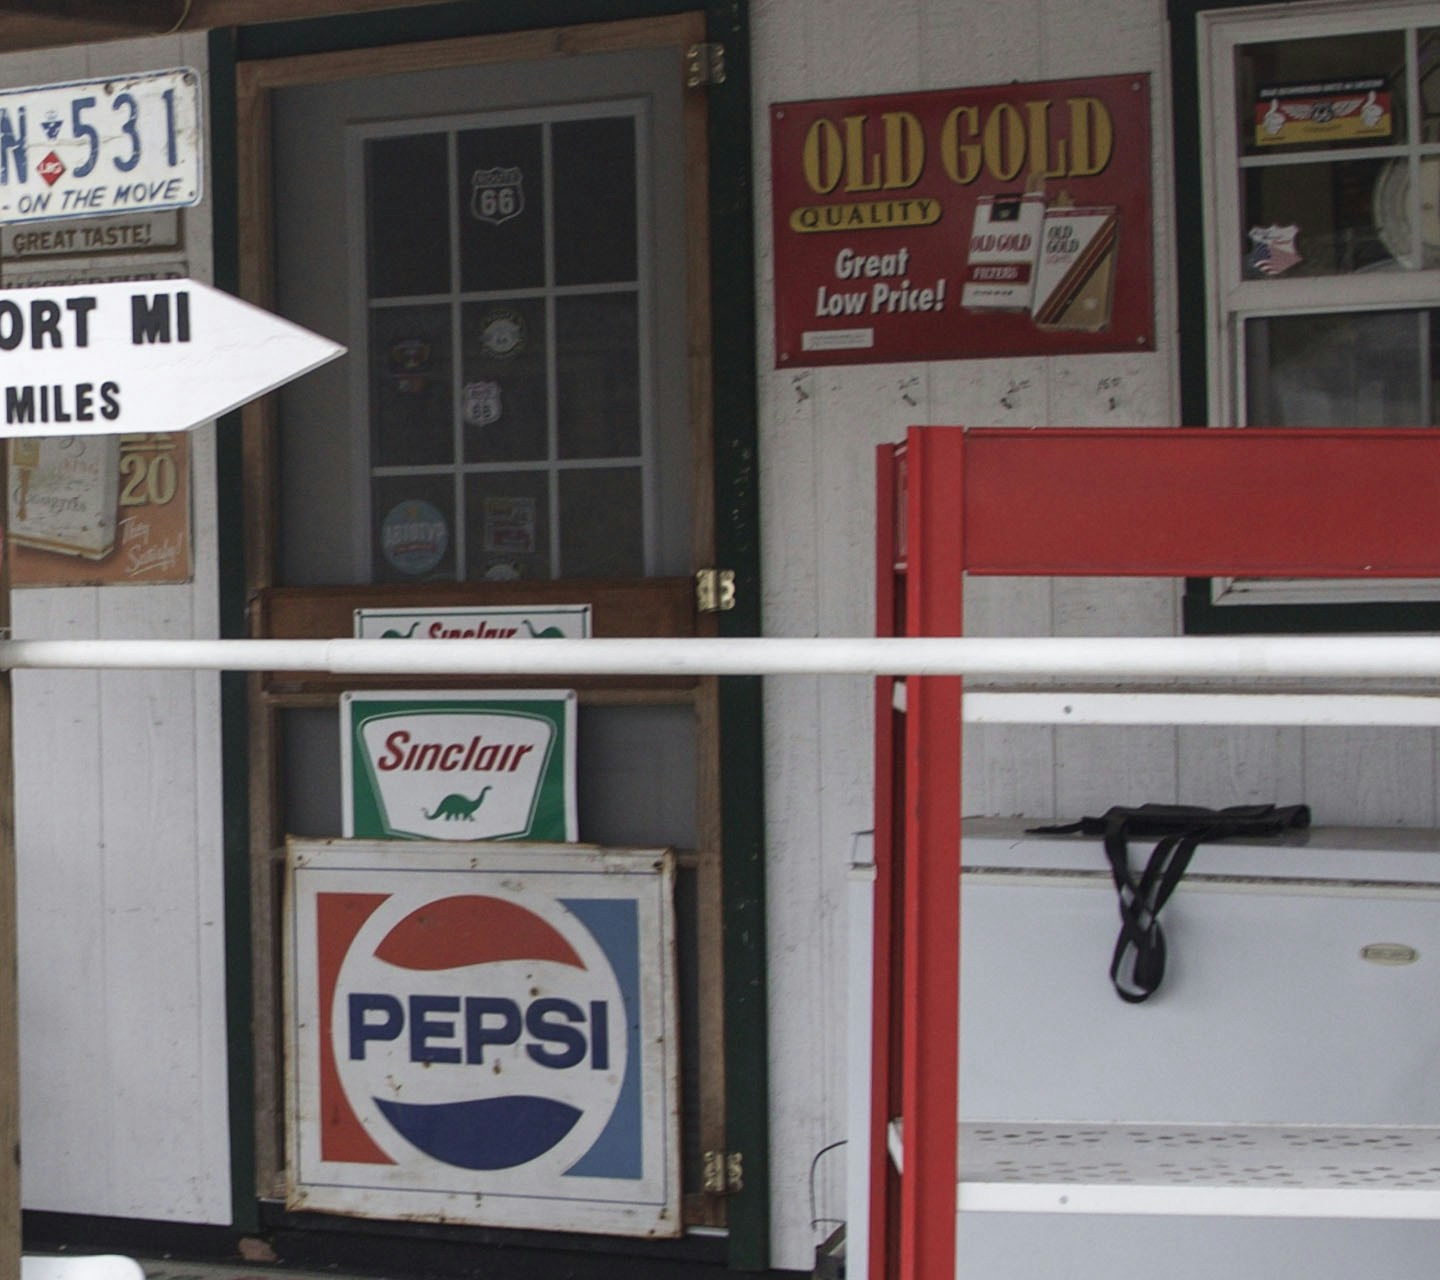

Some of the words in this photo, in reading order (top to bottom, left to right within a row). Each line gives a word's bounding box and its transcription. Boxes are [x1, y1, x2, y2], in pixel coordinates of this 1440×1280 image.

[71, 88, 178, 179] 531
[802, 110, 926, 195] OLD
[941, 96, 1114, 185] GOLD
[18, 193, 52, 214] ON
[61, 186, 109, 209] THE
[113, 178, 183, 203] MOVE
[481, 188, 514, 216] 66
[798, 199, 932, 228] QUALITY
[12, 228, 78, 252] GREAT
[81, 222, 152, 247] TASTE!
[997, 233, 1032, 251] GOLD
[834, 246, 910, 280] Great
[130, 291, 191, 345] MI
[815, 285, 870, 318] Low
[870, 278, 947, 314] Price!
[5, 380, 121, 425] MILES
[119, 453, 178, 506] 20
[377, 730, 534, 773] Sinclair
[348, 992, 610, 1071] PEPSI
